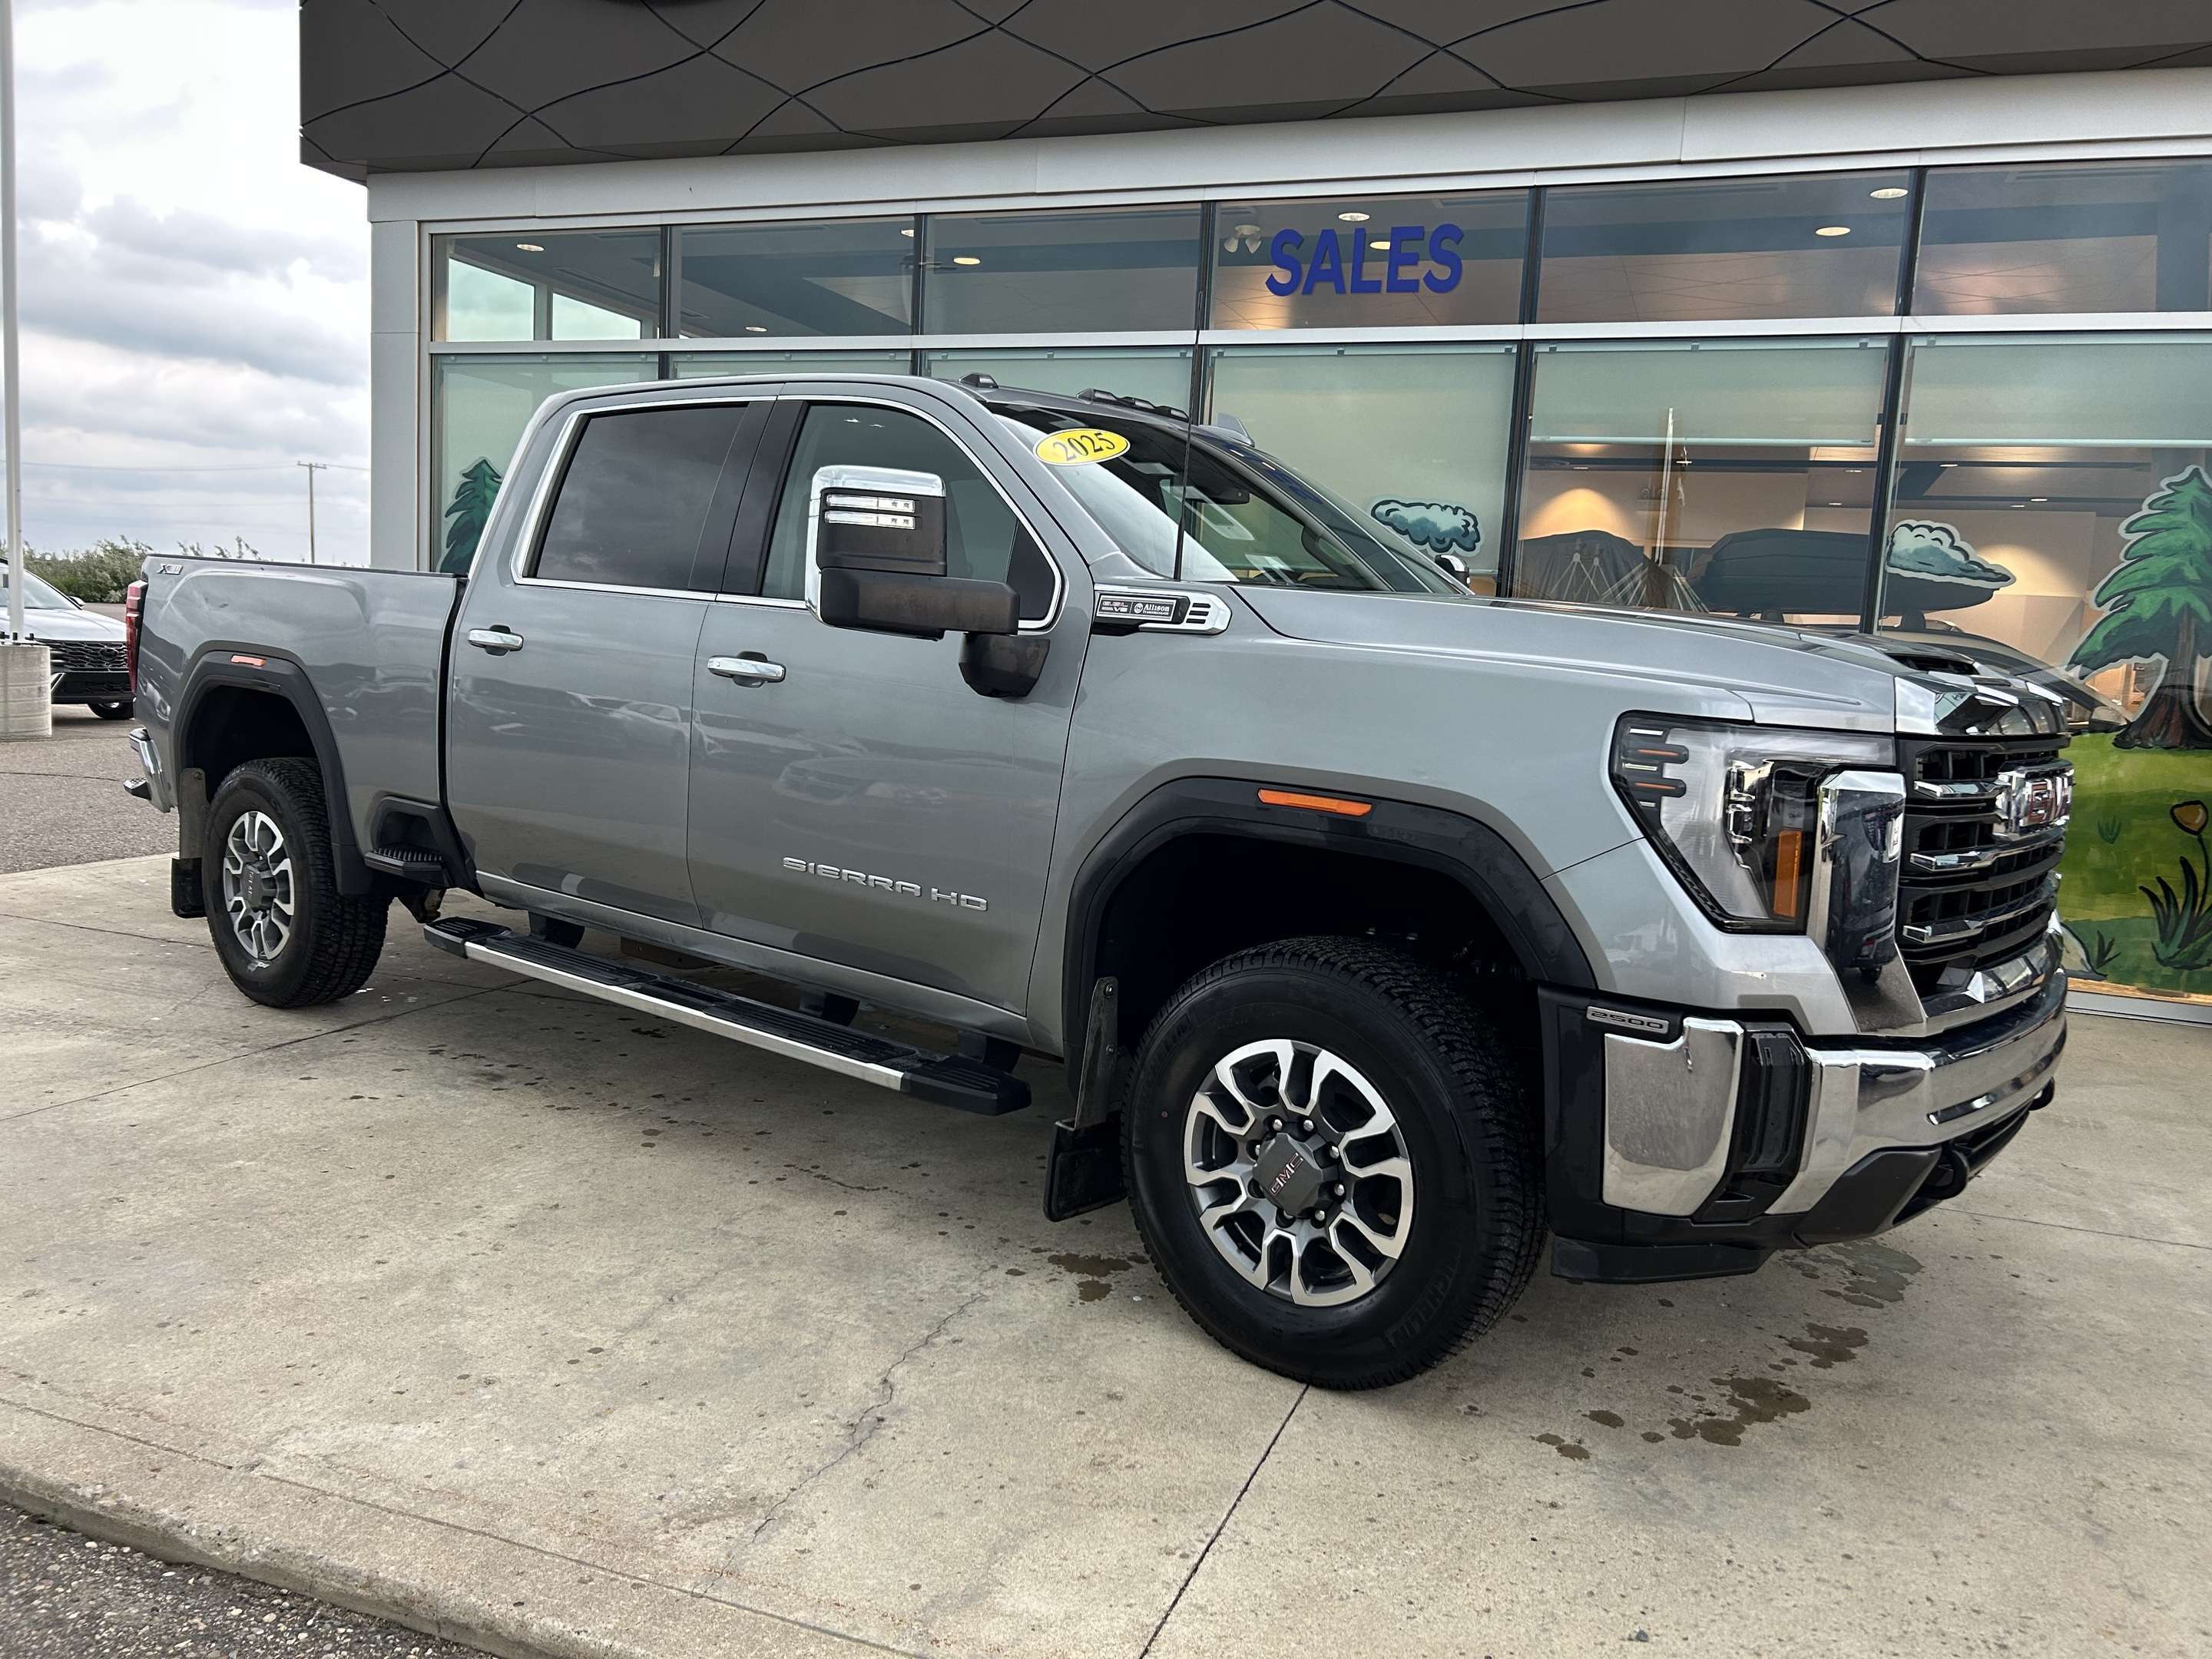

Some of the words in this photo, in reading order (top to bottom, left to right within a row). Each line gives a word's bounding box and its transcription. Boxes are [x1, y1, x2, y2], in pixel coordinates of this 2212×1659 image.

[1265, 224, 1465, 296] SALES
[1053, 432, 1115, 462] 2025
[1144, 604, 1170, 612] Allison
[783, 856, 922, 897] SIERRA
[931, 888, 988, 911] HD
[1591, 1011, 1664, 1029] 2500
[1270, 1152, 1304, 1196] GMC
